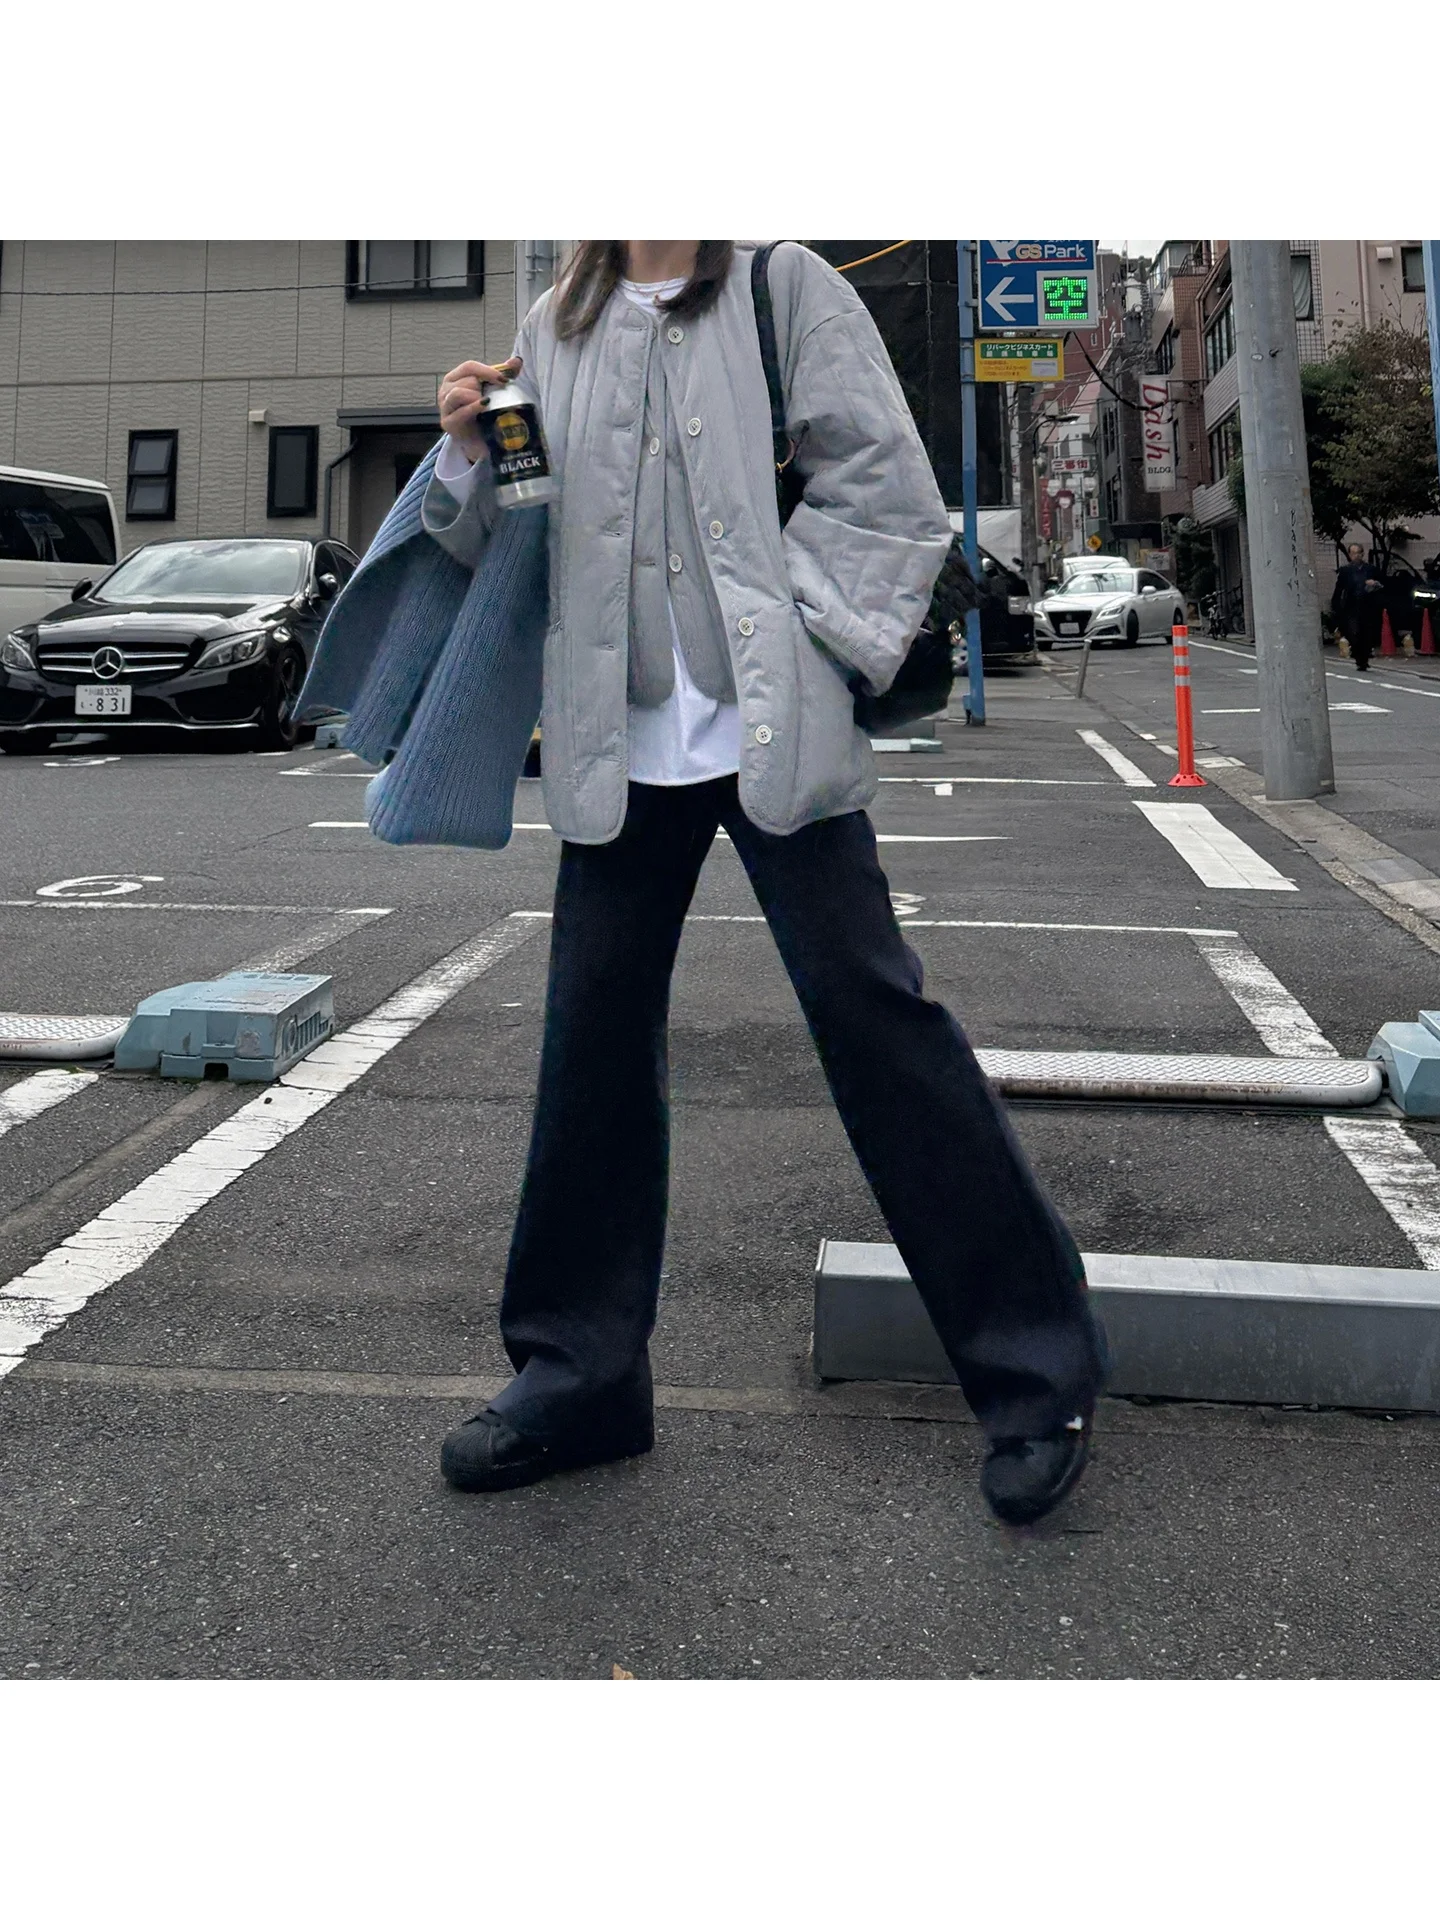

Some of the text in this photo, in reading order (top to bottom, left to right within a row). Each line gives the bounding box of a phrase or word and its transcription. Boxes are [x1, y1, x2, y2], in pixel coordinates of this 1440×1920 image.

[1043, 276, 1088, 320] 空
[1142, 384, 1171, 461] Dash
[500, 456, 541, 474] BLACK
[1053, 460, 1089, 471] 三番街
[104, 687, 119, 696] 332
